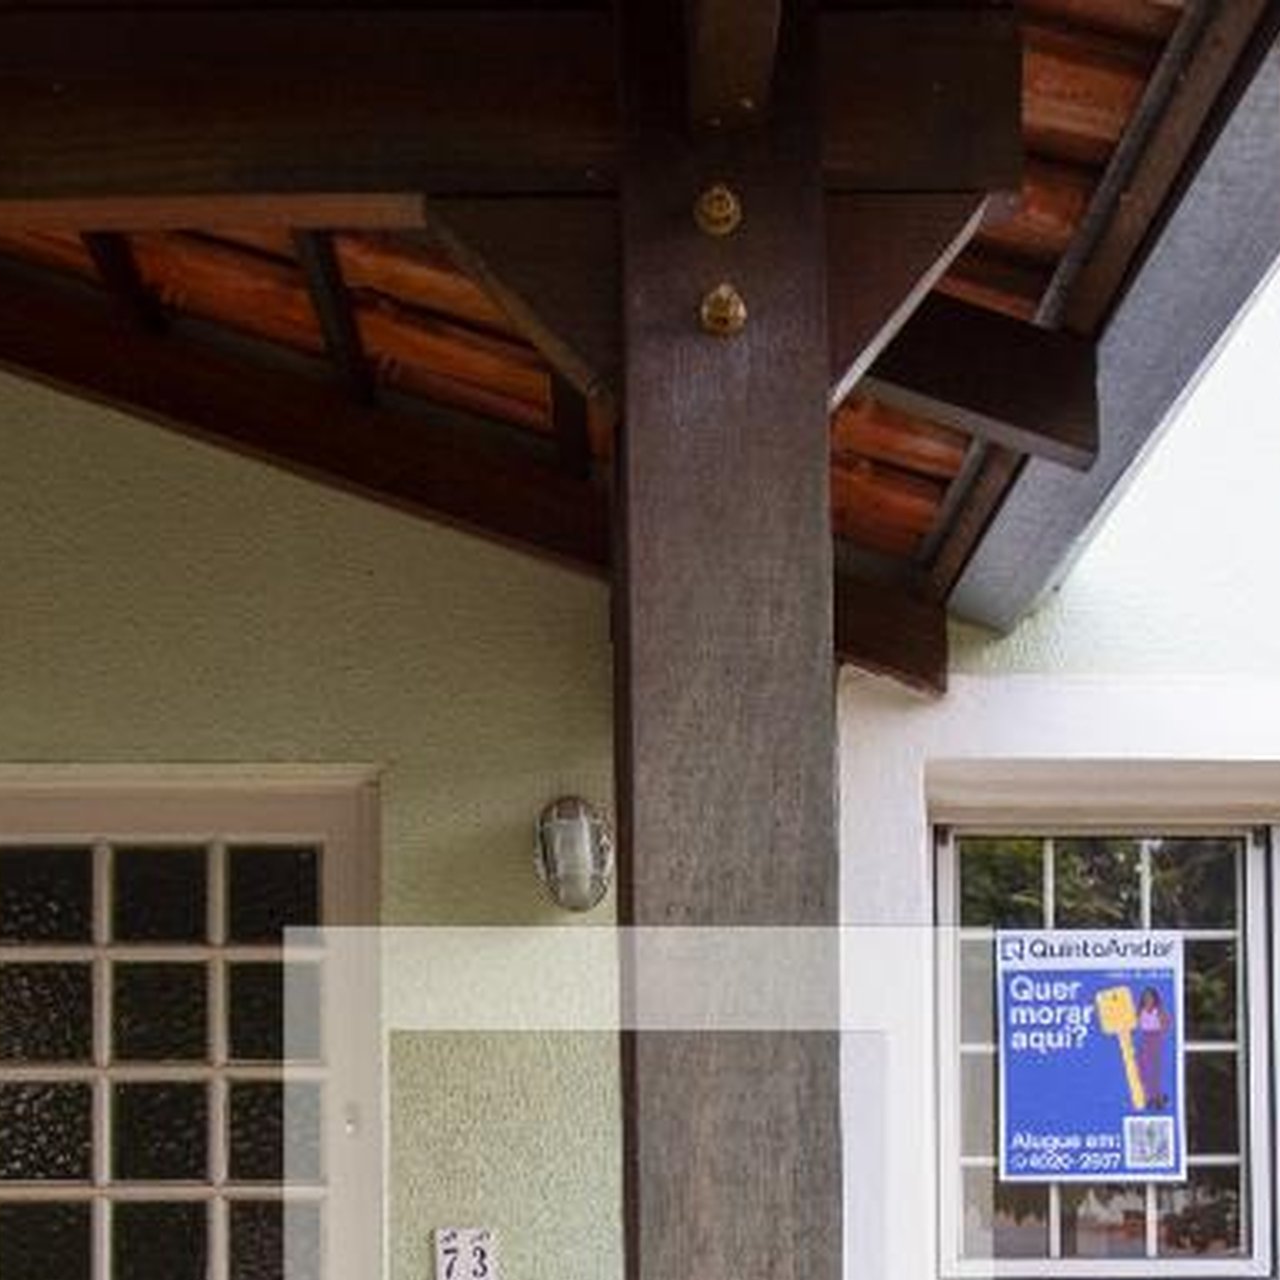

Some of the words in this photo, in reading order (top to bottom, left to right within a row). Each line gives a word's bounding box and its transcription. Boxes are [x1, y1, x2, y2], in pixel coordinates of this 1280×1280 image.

[1028, 938, 1174, 958] QuintoAndar
[1010, 975, 1082, 1001] Quer
[1010, 1005, 1094, 1024] morar
[1012, 1026, 1087, 1053] aqui?
[1013, 1133, 1081, 1153] Alugue
[443, 1246, 488, 1280] 73
